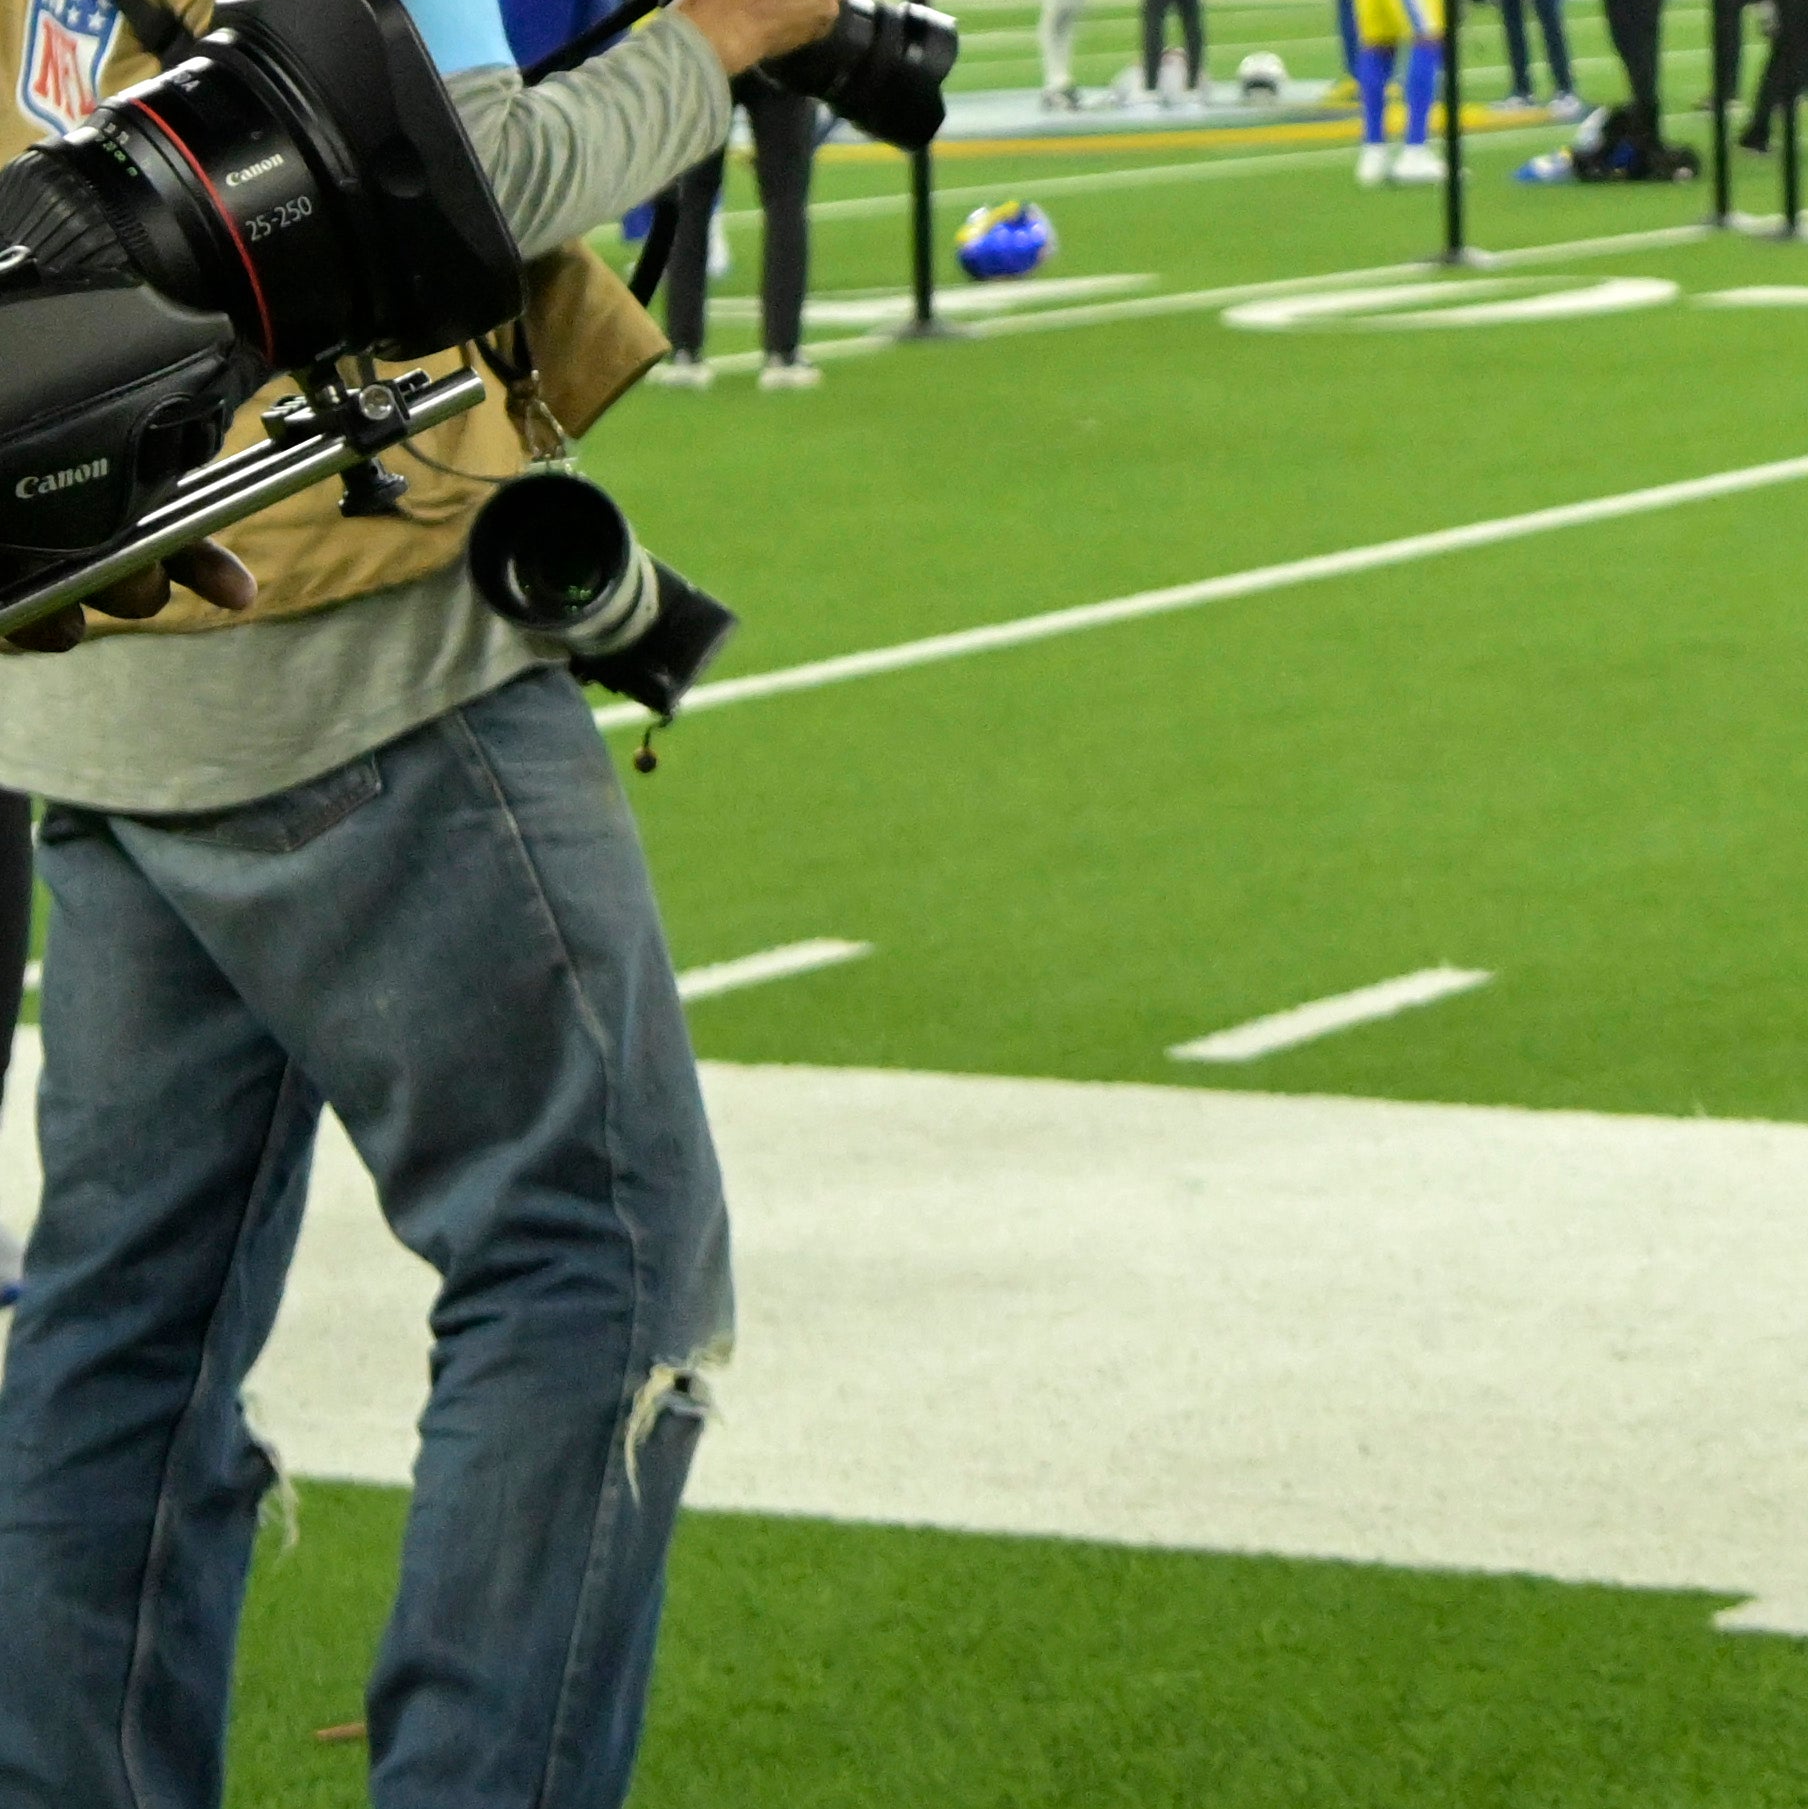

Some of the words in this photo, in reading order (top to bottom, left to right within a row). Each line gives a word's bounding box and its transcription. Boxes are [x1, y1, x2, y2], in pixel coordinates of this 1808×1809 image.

[34, 18, 97, 120] NFL
[225, 153, 285, 186] Canon
[246, 195, 313, 242] 25-250
[15, 457, 108, 499] Canon
